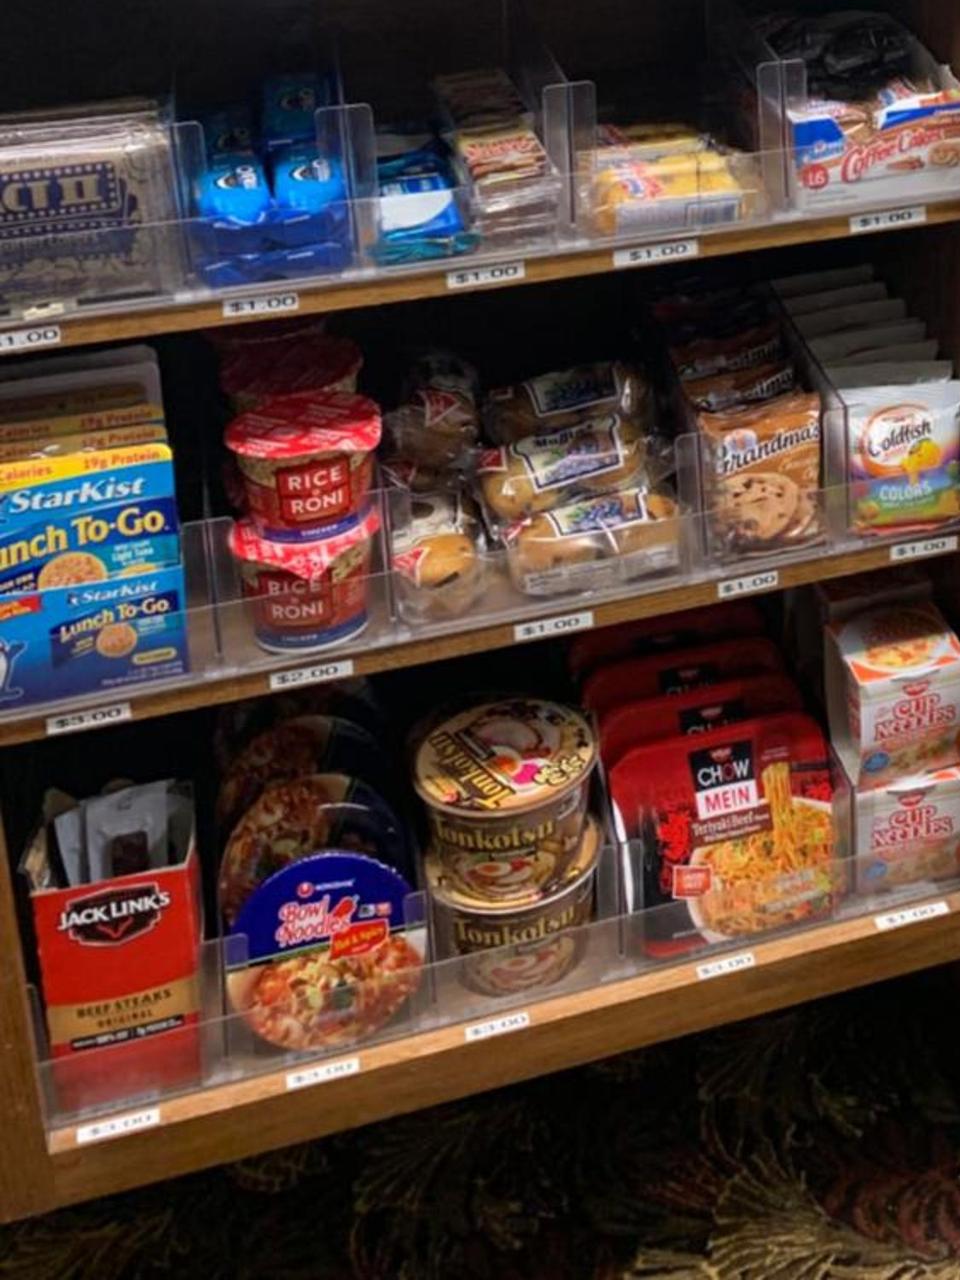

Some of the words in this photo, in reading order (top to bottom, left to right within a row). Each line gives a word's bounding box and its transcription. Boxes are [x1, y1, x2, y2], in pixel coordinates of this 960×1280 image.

[0, 180, 50, 215] CT
[860, 211, 912, 227] $1.00
[629, 244, 688, 260] $1.00
[455, 266, 518, 283] $1.00
[228, 295, 297, 313] $1.00
[867, 419, 934, 458] Goldfish
[111, 450, 161, 466] Protein
[287, 467, 343, 491] RICE
[9, 475, 146, 514] StarKist
[290, 489, 344, 515] RONI
[0, 526, 68, 570] nch
[74, 506, 165, 546] To-Go
[895, 540, 947, 557] $1.00
[81, 580, 159, 603] StarKist
[268, 577, 323, 596] RICE
[722, 573, 776, 593] $1.00
[60, 609, 114, 643] Lunch
[116, 597, 170, 618] To-Go
[272, 599, 325, 620] RONI
[522, 616, 580, 636] $1.00
[276, 665, 339, 685] $2.00
[892, 693, 941, 720] CUP
[874, 704, 956, 742] NOODLES
[697, 757, 750, 787] CHOW
[704, 785, 750, 813] MEIN
[889, 805, 937, 829] CUP
[434, 819, 555, 852] Tonkotsu
[870, 817, 954, 851] NOODLES
[58, 904, 109, 932] JACK
[111, 891, 171, 919] LINK'S
[278, 894, 330, 922] Bowl
[456, 906, 576, 947] Tonkotsu
[114, 988, 173, 1012] STEAKS
